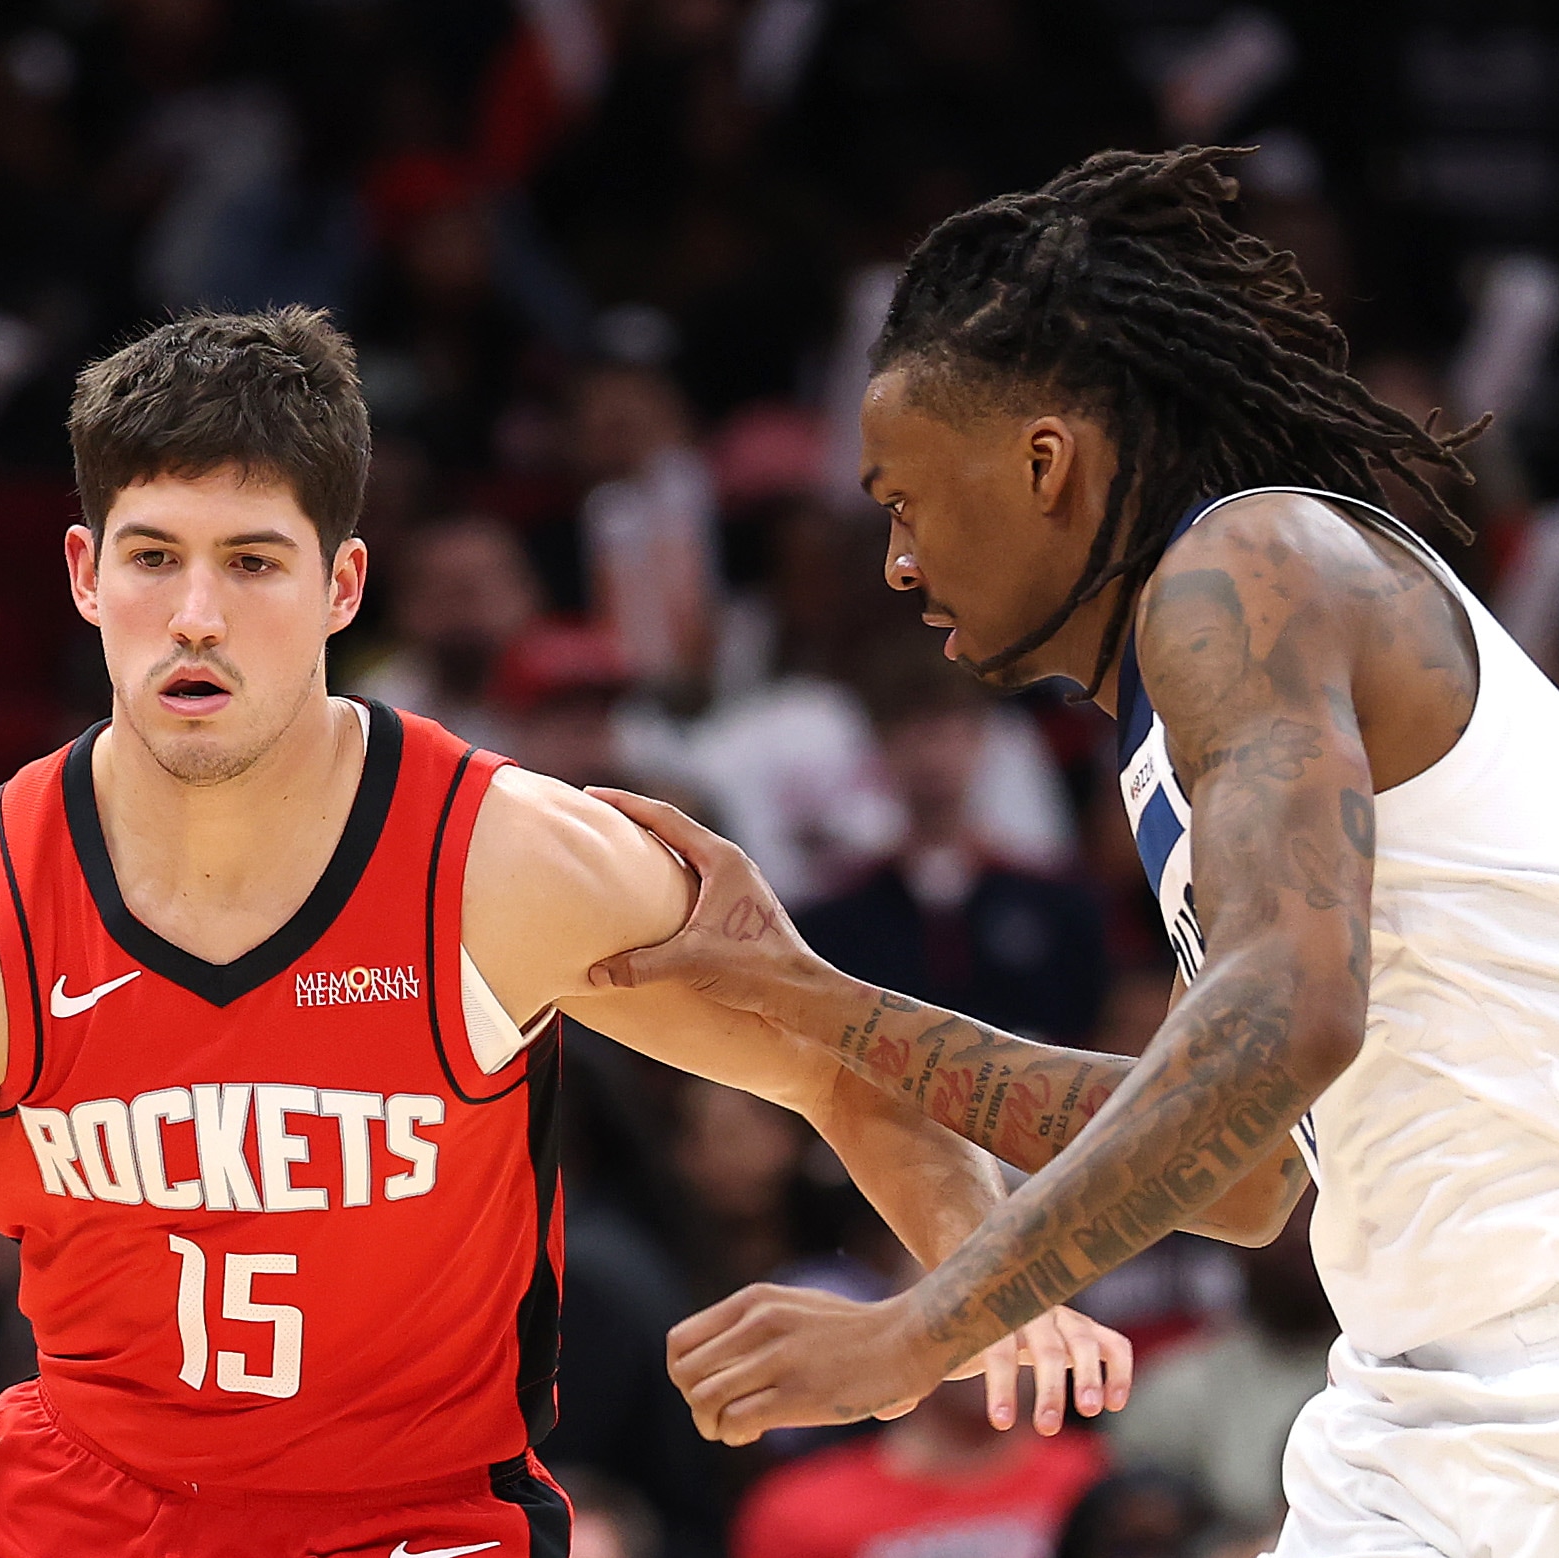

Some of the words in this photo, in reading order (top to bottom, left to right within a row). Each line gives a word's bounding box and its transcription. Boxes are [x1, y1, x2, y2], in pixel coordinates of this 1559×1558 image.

[295, 966, 420, 991] MEMORIAL
[296, 981, 419, 1007] HERMANN
[17, 1083, 444, 1213] ROCKETS
[169, 1235, 303, 1399] 15
